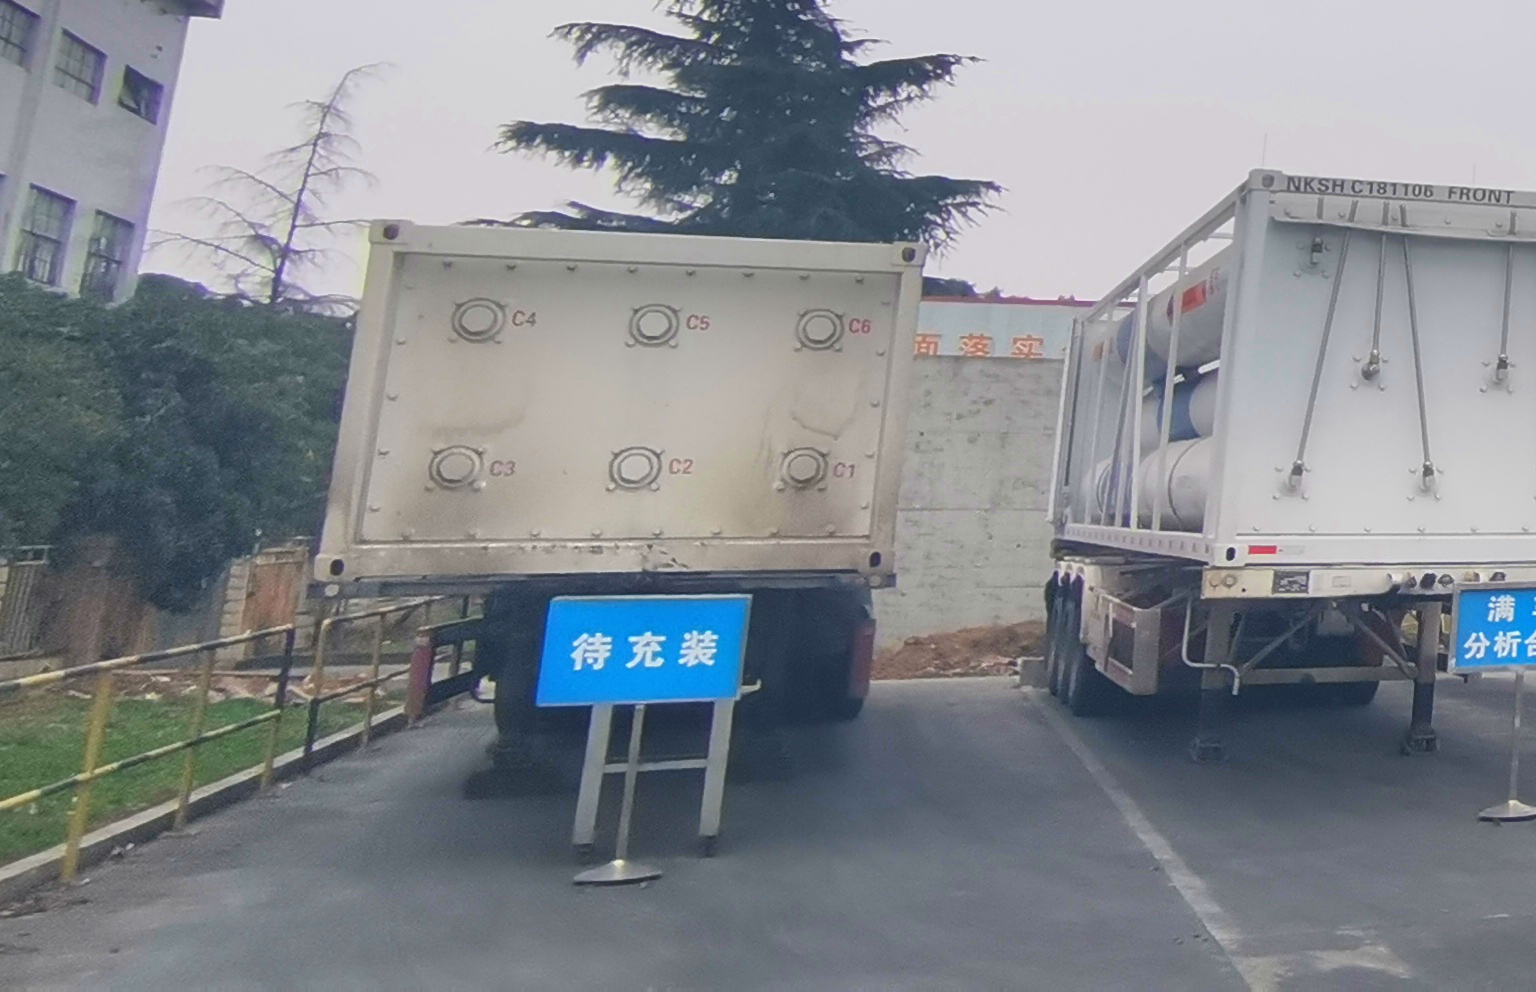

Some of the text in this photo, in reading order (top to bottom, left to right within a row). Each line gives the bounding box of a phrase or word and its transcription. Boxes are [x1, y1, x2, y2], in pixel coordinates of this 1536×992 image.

[1286, 176, 1515, 204] NKSH C181106 FRONT
[512, 310, 537, 327] C4
[686, 314, 710, 331] C5
[849, 318, 871, 334] C6
[490, 460, 515, 477] C3
[669, 458, 693, 474] C2
[834, 462, 855, 478] C1
[570, 630, 719, 670] 待充装
